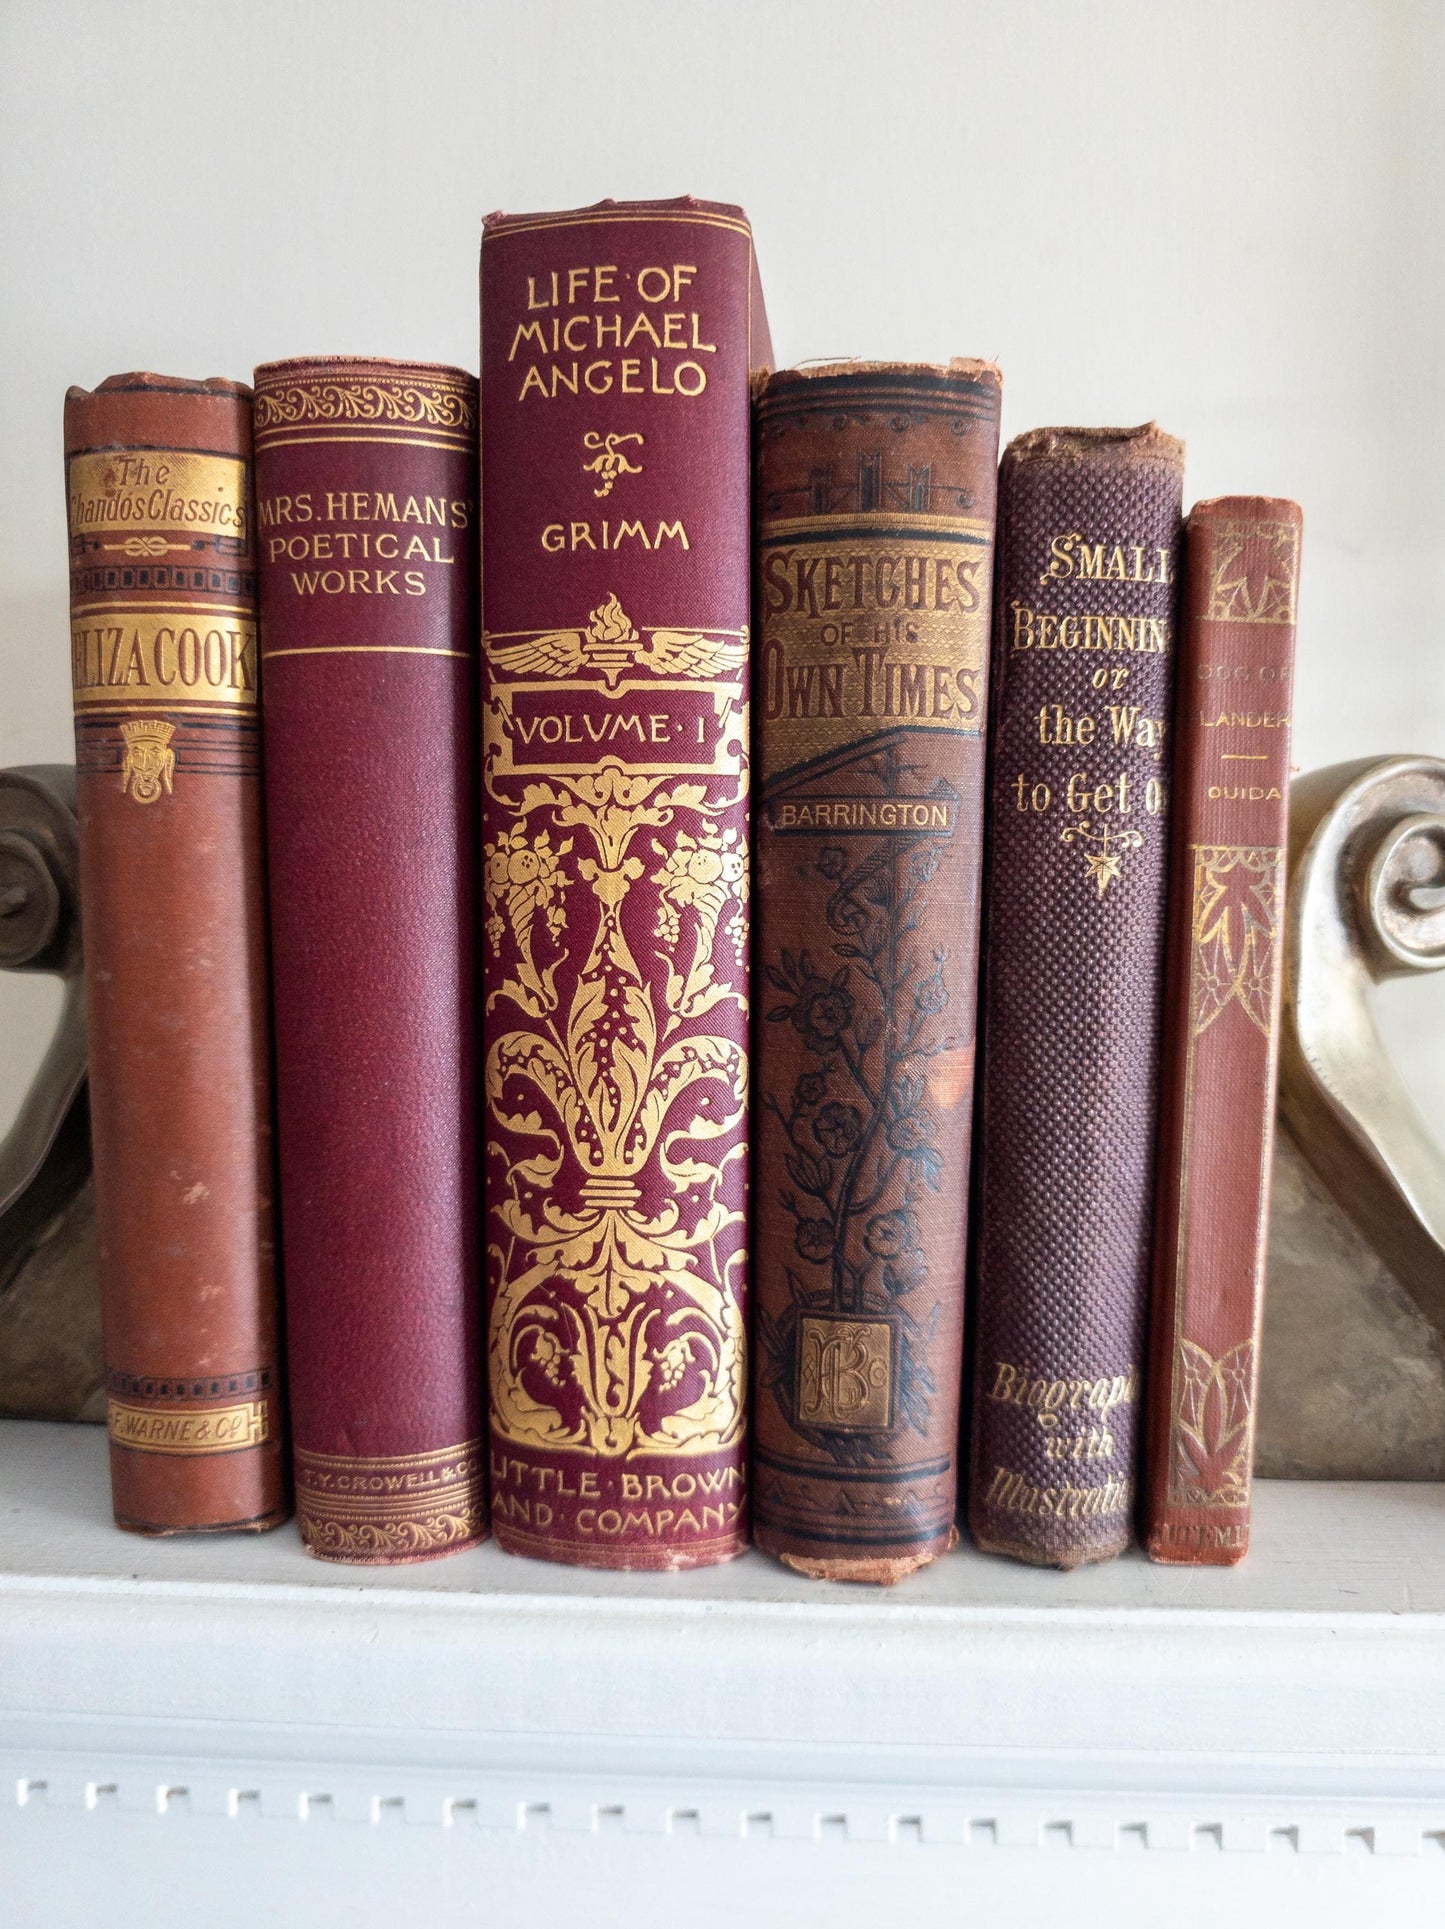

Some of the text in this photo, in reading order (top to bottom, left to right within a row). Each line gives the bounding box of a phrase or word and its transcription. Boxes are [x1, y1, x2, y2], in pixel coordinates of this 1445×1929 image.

[527, 264, 697, 310] LIFE OF
[508, 312, 717, 361] MICHAEL
[518, 356, 708, 401] ANGELO
[118, 457, 170, 487] The
[149, 488, 245, 528] Classics
[258, 495, 322, 530] MRS.
[268, 533, 454, 564] POETICAL
[541, 519, 690, 552] GRIMM
[290, 569, 427, 596] WORKS
[765, 549, 981, 622] SKETCHES
[820, 617, 920, 646] OF HIS
[1010, 600, 1172, 658] BEGINNIN
[73, 627, 255, 691] ELIZA COOK
[1091, 667, 1130, 689] or
[761, 639, 980, 720] OWN TIMES
[696, 716, 705, 743] I
[1033, 704, 1166, 761] the Way
[1011, 772, 1051, 812] to
[1066, 772, 1134, 813] Get
[1207, 785, 1283, 801] OUIDA
[781, 804, 949, 827] BARRINGTON
[1047, 1425, 1114, 1459] with
[490, 1450, 745, 1500] LITTLE BROWN
[491, 1490, 747, 1537] AND COMPANY
